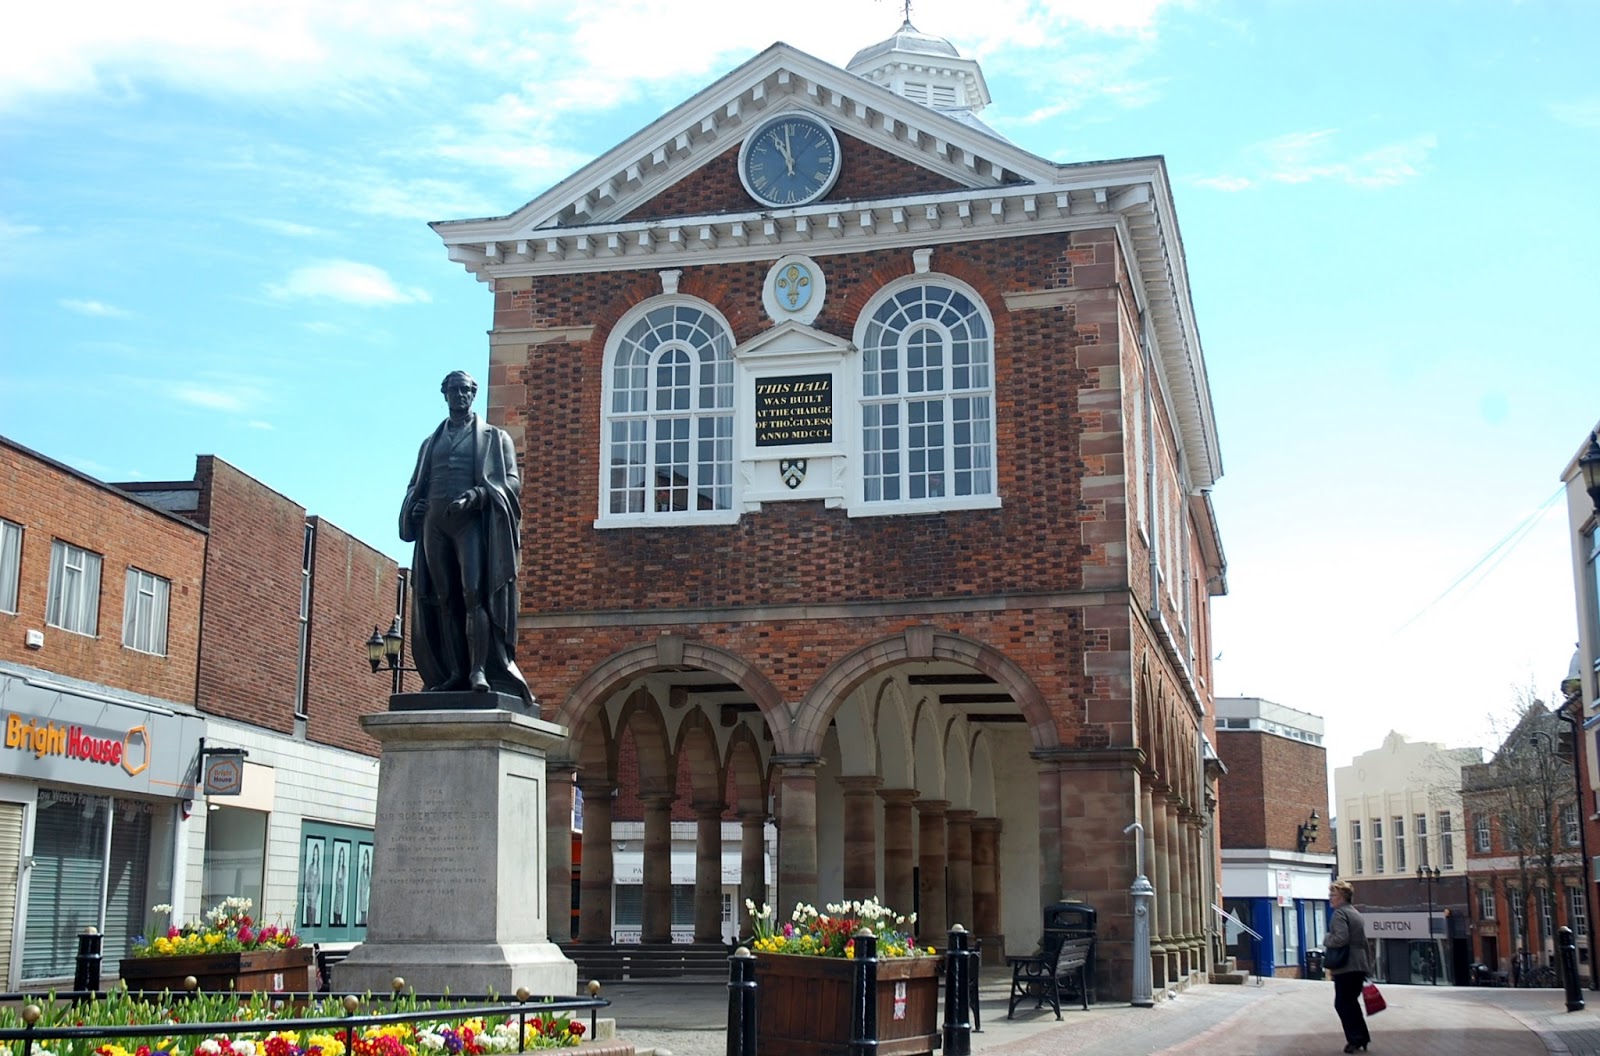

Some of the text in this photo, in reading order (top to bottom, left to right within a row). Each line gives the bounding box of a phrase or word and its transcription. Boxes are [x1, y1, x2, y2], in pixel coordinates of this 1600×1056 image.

[757, 381, 829, 394] THIS HALL
[764, 395, 823, 406] WAS BUILT
[757, 405, 831, 418] AT THE CHARGE
[755, 421, 767, 429] OF
[760, 431, 789, 441] ANNO
[6, 713, 122, 765] Bright House
[214, 769, 232, 777] Bright
[52, 789, 77, 807] Weekly
[379, 812, 395, 822] SIR
[399, 811, 437, 821] ROBERT
[1373, 921, 1411, 931] BURTON
